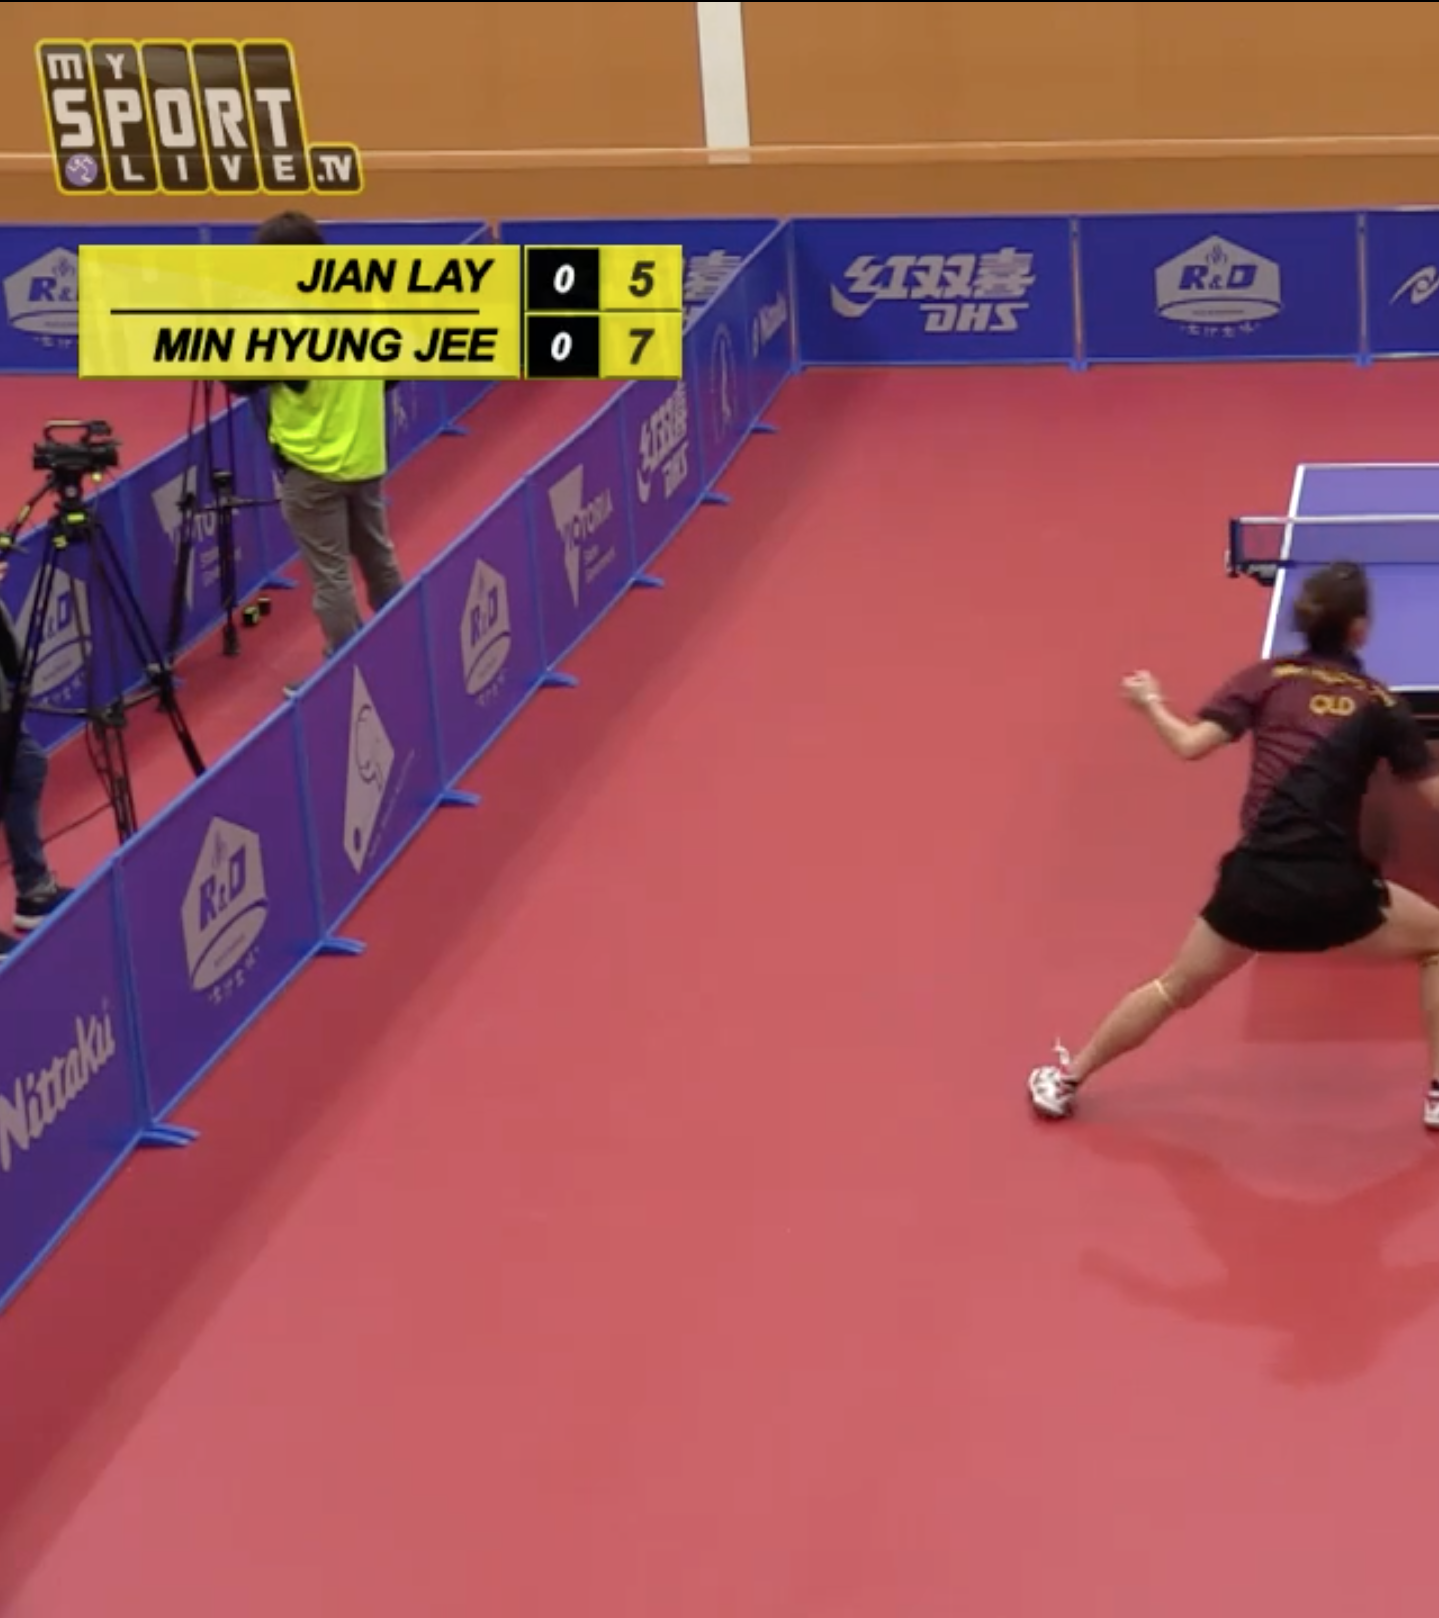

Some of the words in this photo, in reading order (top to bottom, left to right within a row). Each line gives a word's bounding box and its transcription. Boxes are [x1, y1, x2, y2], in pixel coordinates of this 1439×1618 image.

[28, 276, 78, 302] R&
[830, 247, 1036, 318] 红双喜
[1178, 264, 1258, 291] R&D
[919, 303, 1030, 332] DHS
[1309, 694, 1356, 716] QLD
